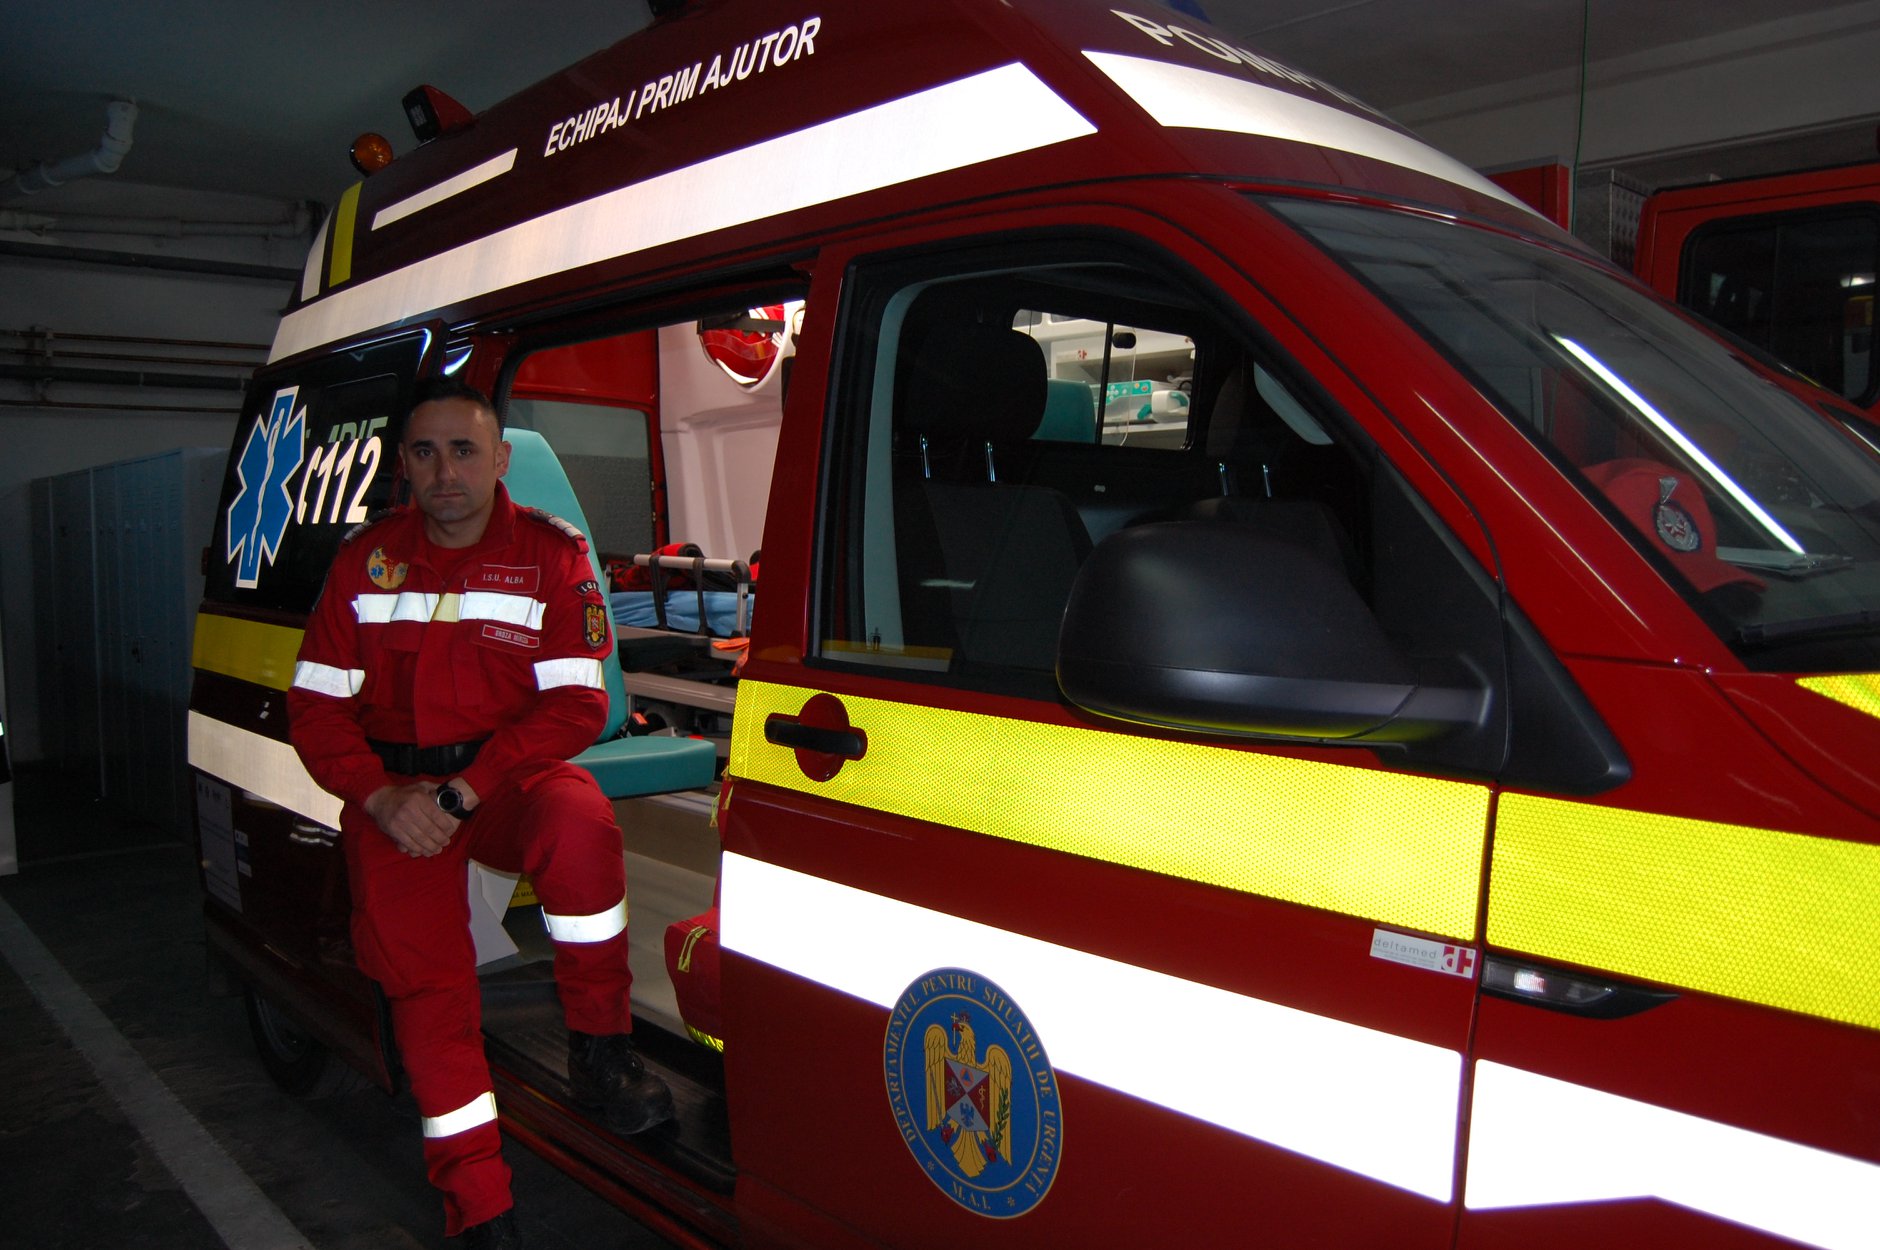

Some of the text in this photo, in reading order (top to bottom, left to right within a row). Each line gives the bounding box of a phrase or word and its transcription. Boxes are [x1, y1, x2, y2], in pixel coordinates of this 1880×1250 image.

[543, 16, 822, 158] ECHIPAJ PRIM AJUTOR
[311, 435, 382, 524] 112
[504, 575, 524, 584] ALBA
[1373, 938, 1438, 960] deltamed
[887, 991, 920, 1143] DEPARTAMENTUL
[921, 974, 977, 997] PENTRU
[1036, 1070, 1053, 1098] DE
